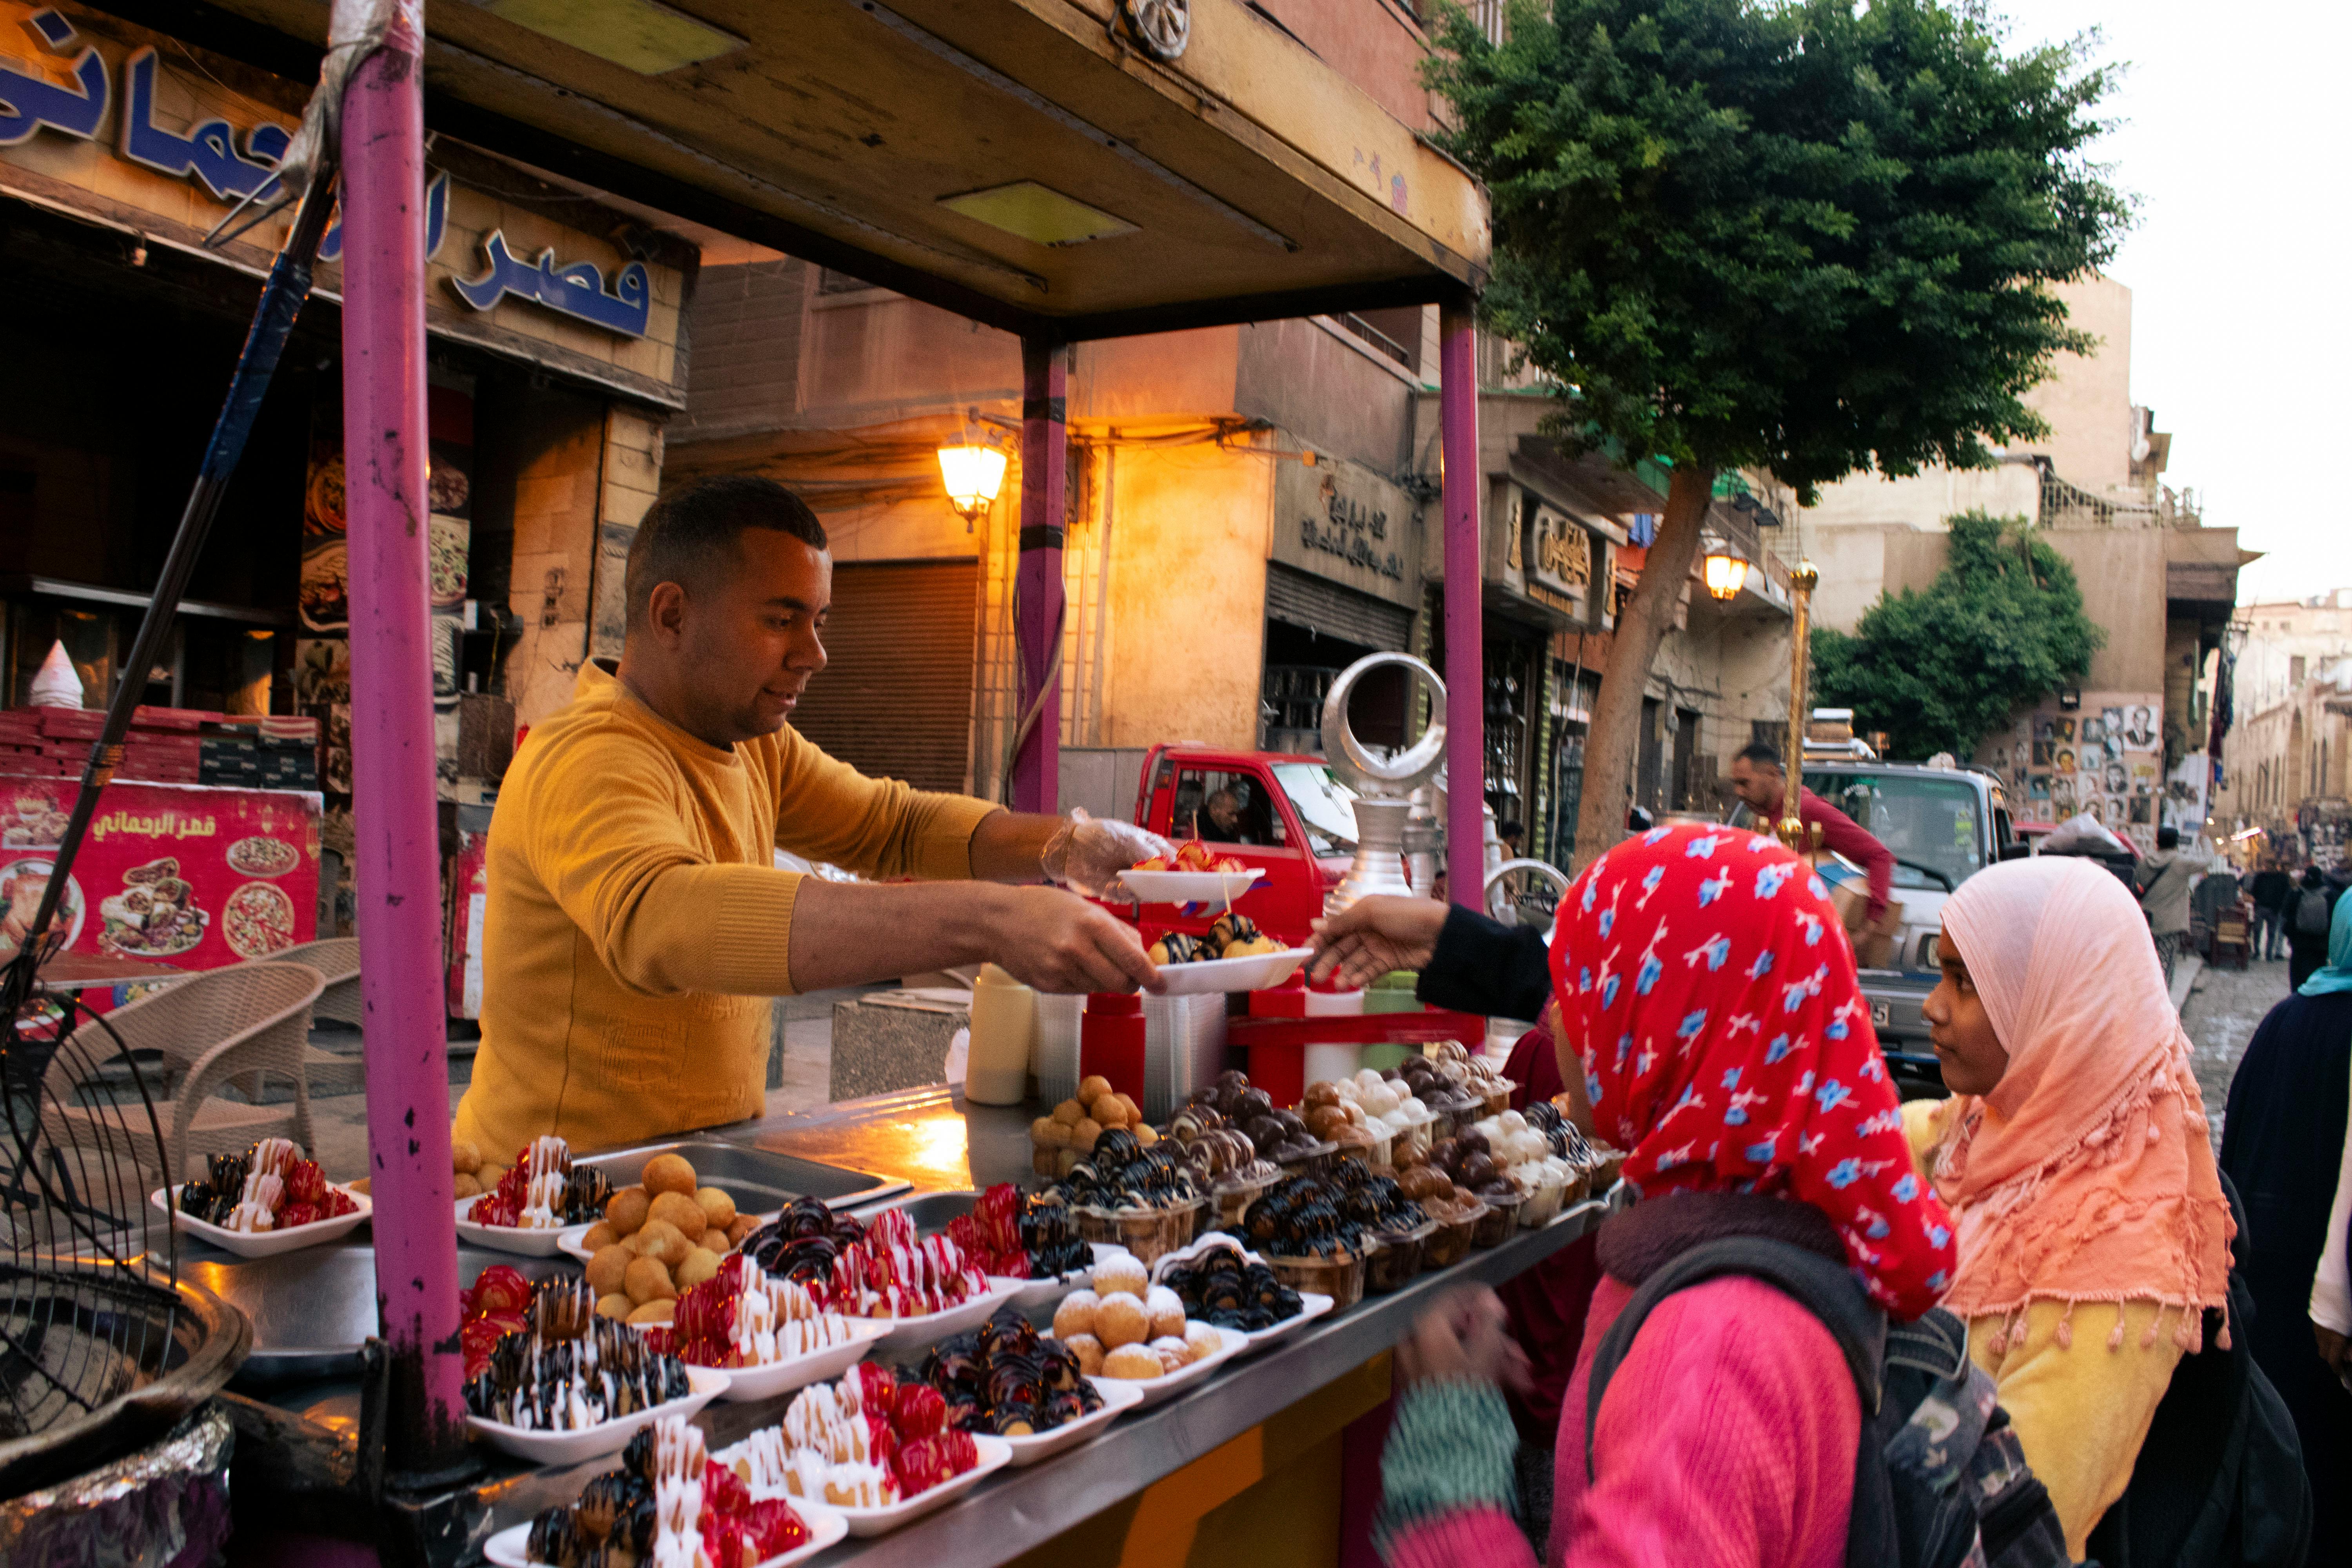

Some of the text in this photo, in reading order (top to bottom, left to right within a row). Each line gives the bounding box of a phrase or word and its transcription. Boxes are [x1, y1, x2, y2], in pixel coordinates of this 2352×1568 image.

[450, 223, 659, 339] قصر
[93, 810, 215, 842] قصر الرحماني
